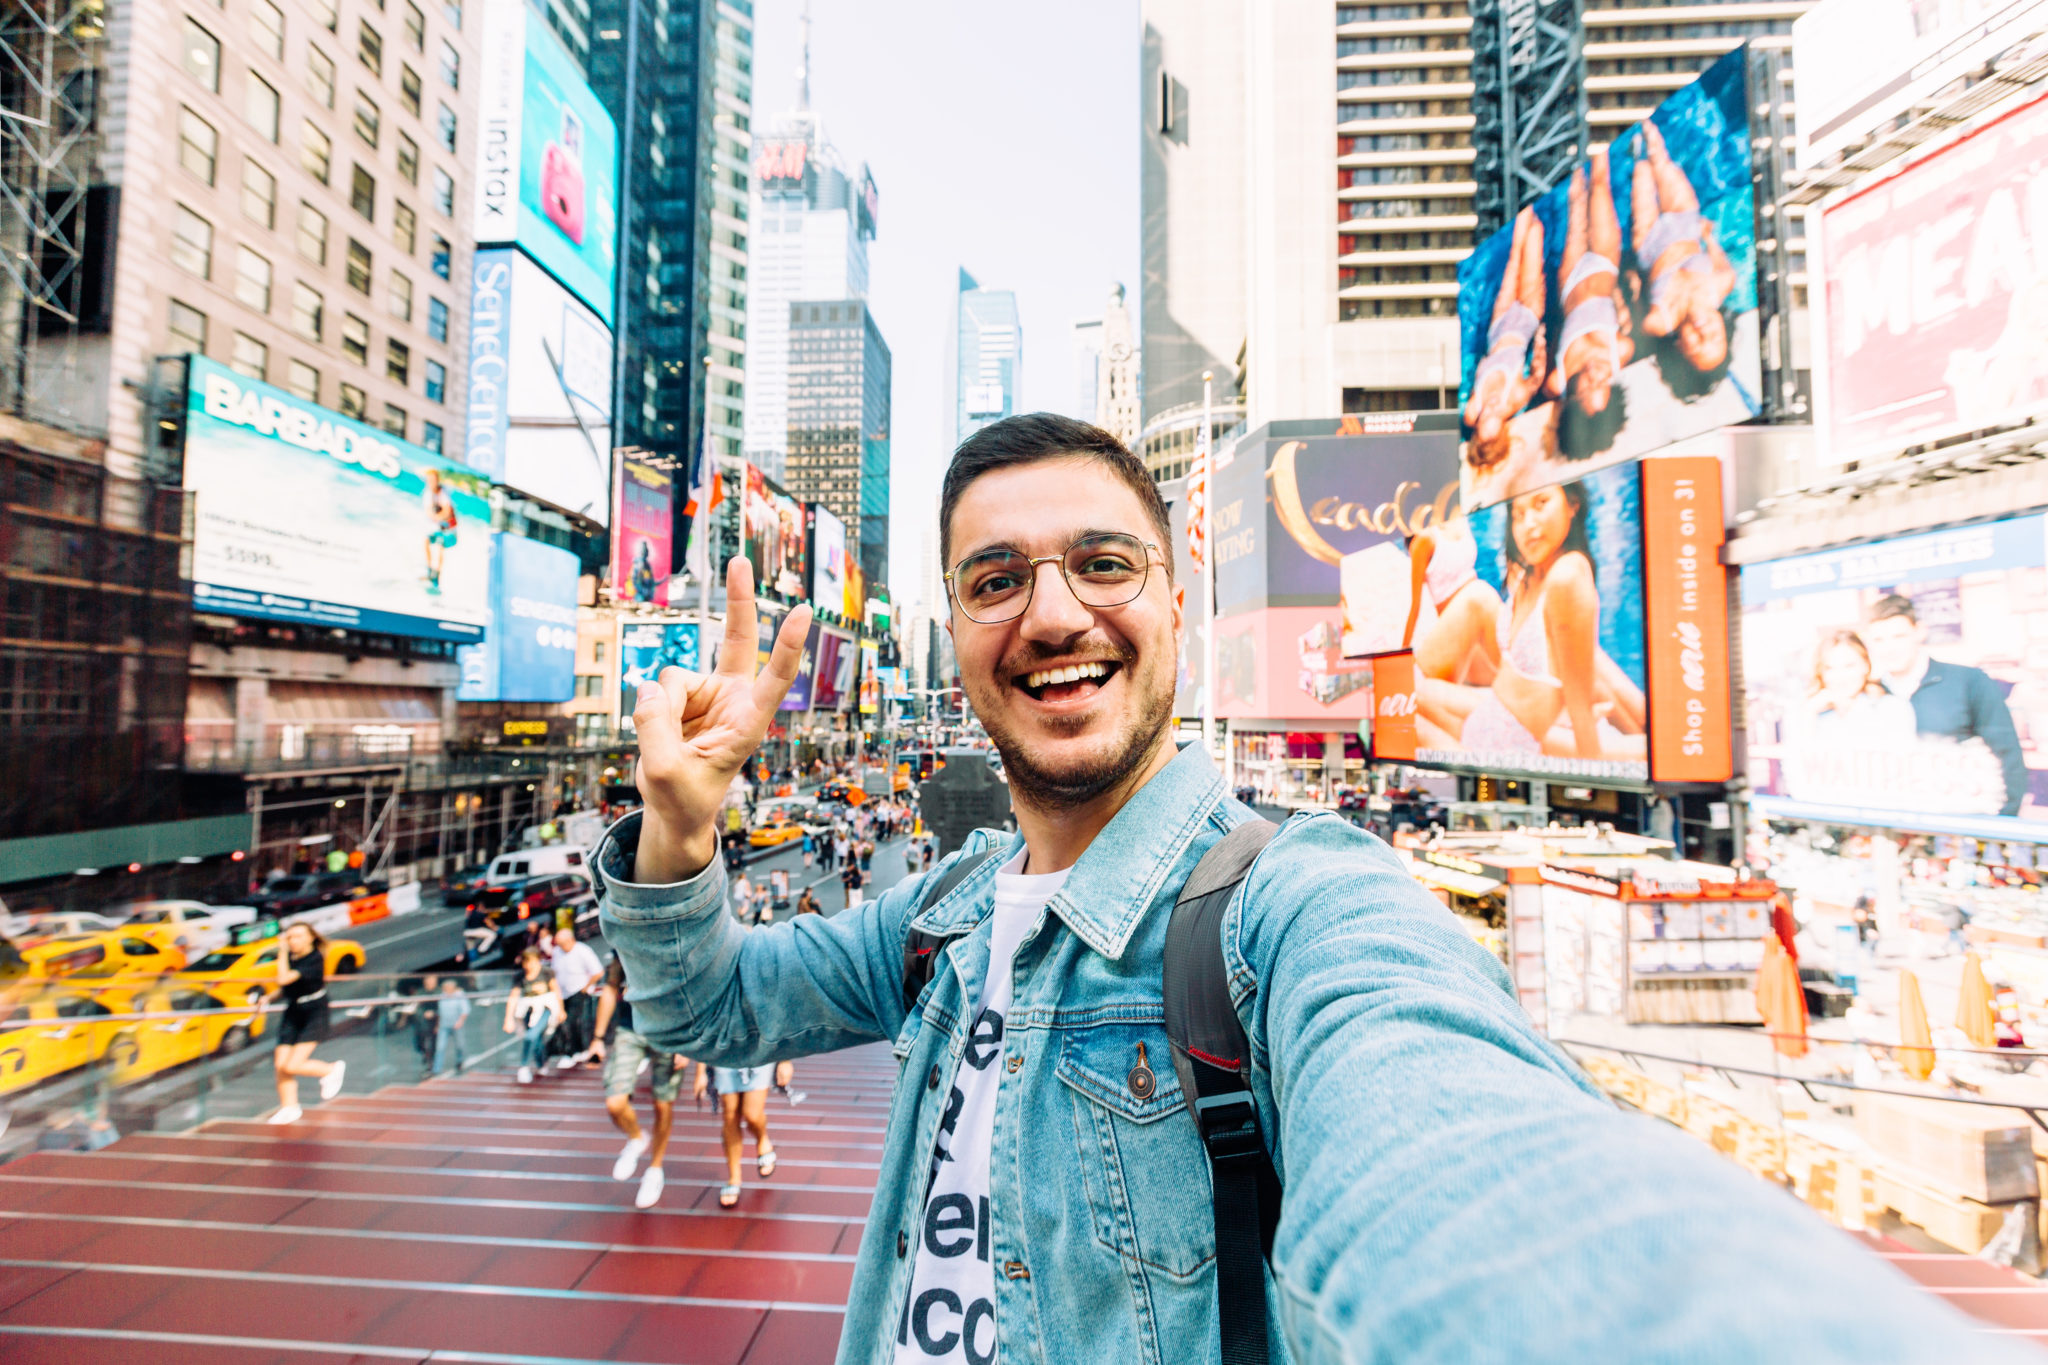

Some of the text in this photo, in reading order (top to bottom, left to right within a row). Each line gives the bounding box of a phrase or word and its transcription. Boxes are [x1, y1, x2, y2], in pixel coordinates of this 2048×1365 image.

[484, 119, 510, 217] instax
[1841, 172, 2048, 360] MEA
[204, 373, 401, 478] BARBADOS
[1214, 527, 1256, 567] AYING
[1680, 508, 1696, 536] on
[1676, 544, 1699, 611] inside
[1672, 621, 1705, 692] aerie
[1682, 698, 1706, 756] Shop
